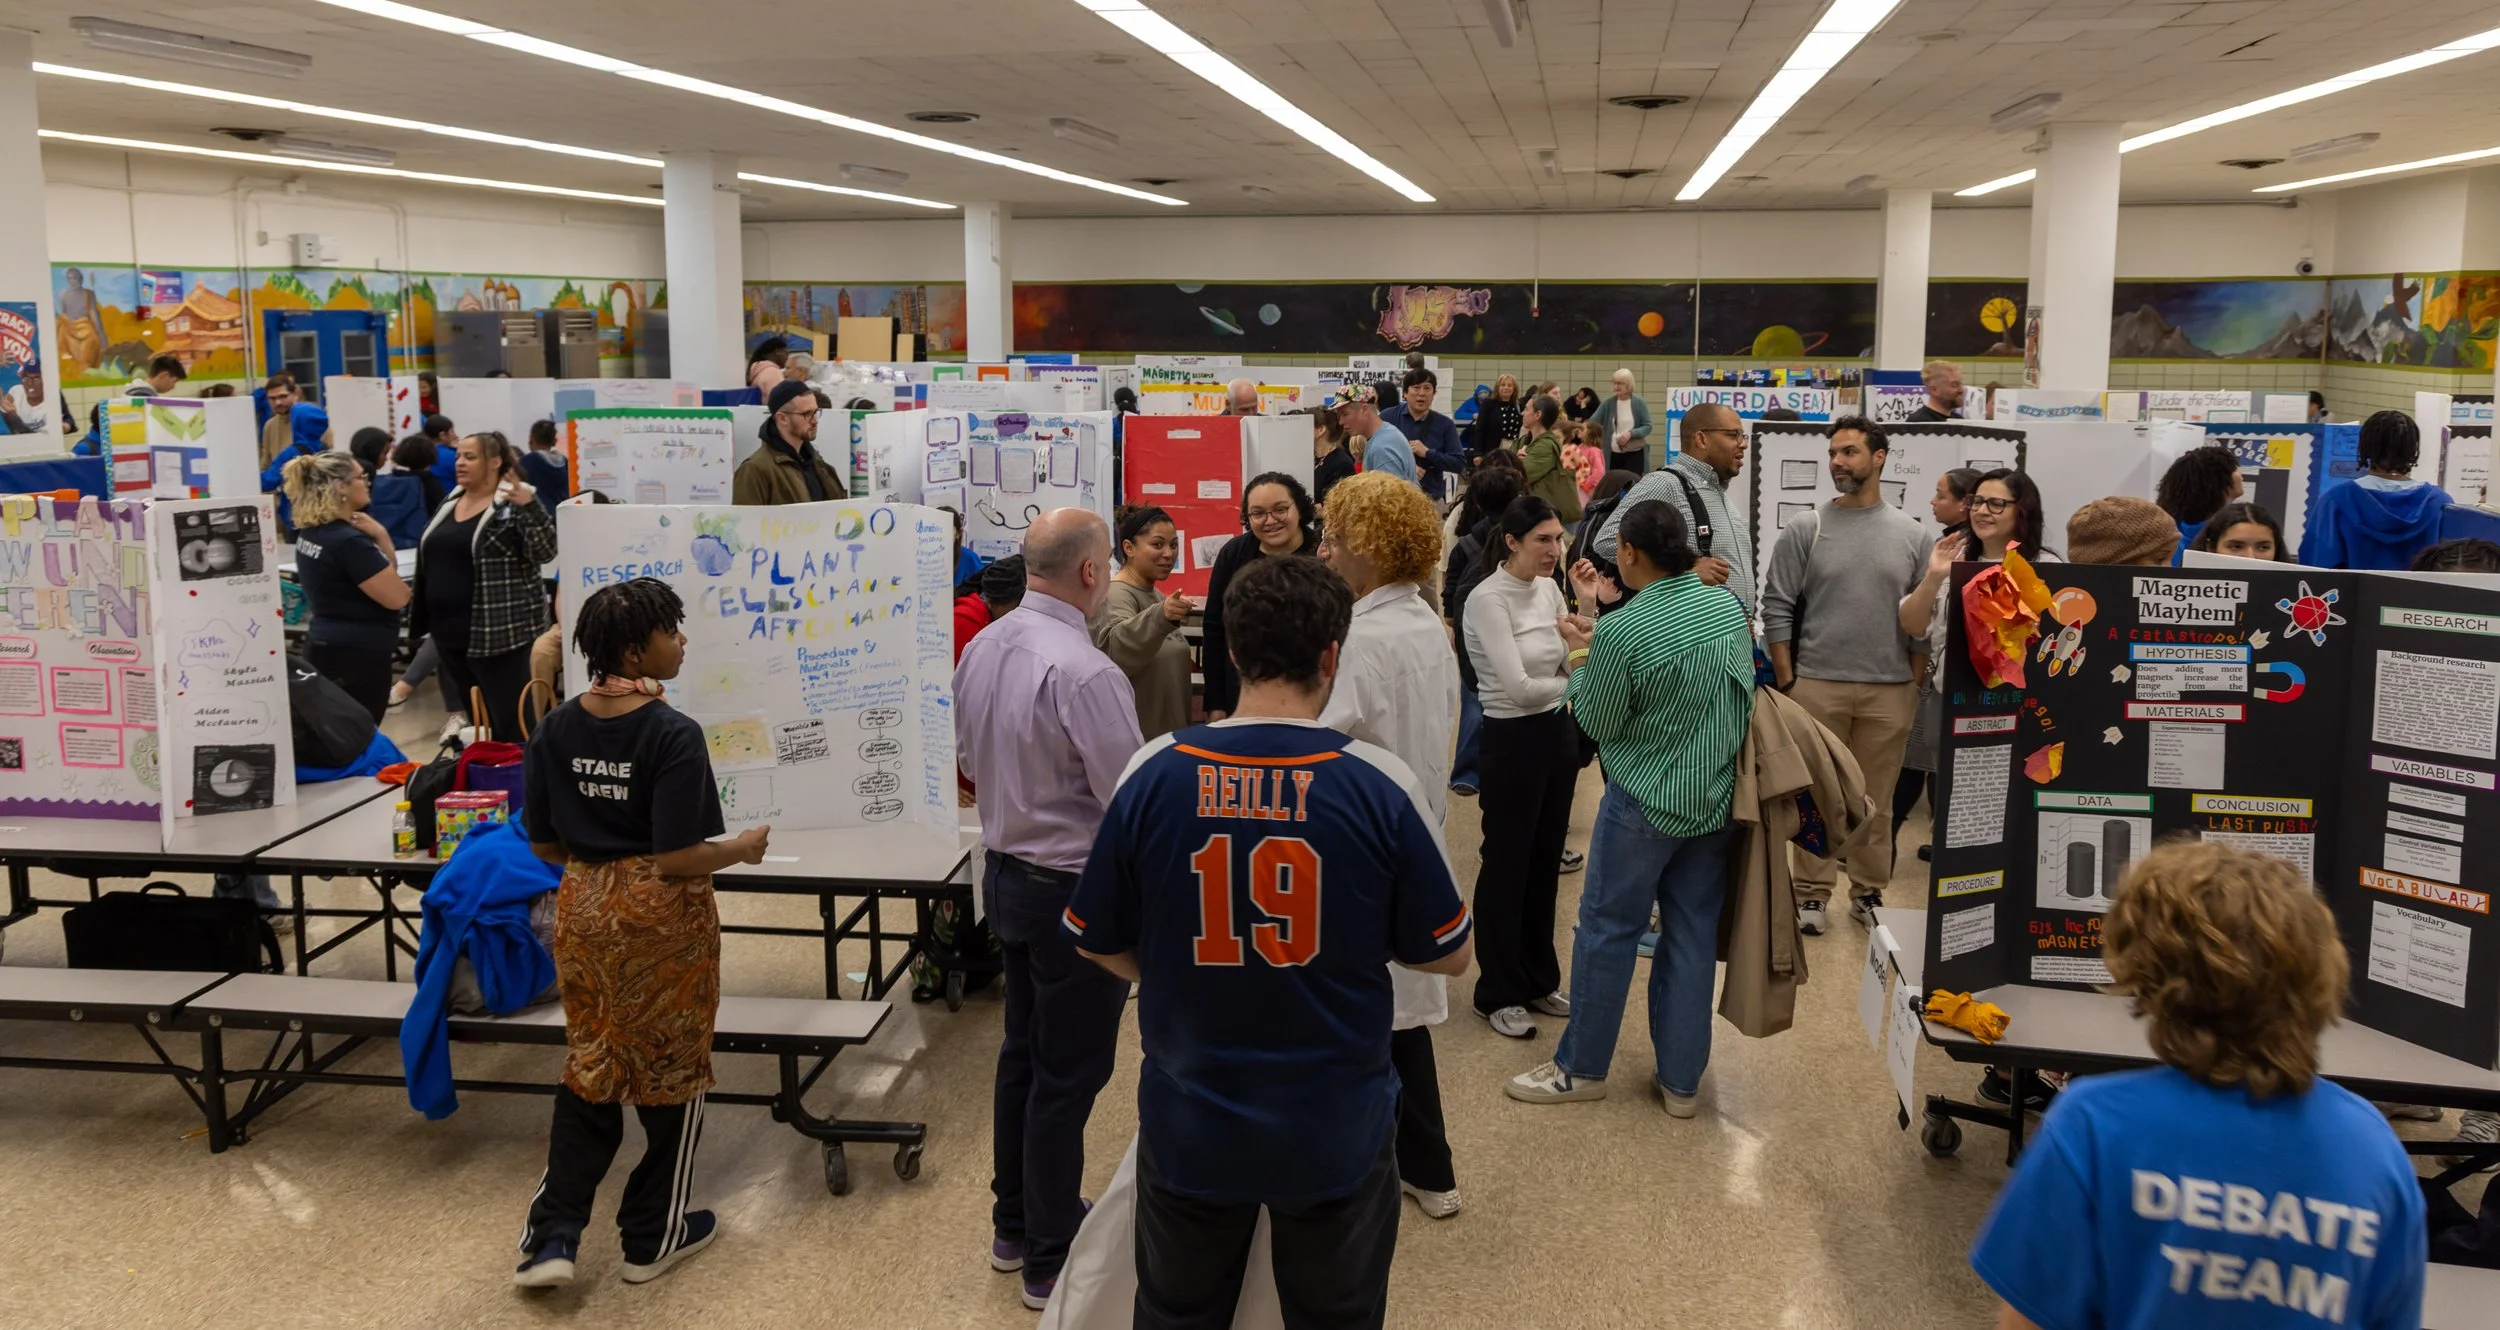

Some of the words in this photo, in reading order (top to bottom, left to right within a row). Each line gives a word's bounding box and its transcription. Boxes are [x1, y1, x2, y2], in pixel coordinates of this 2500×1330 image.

[1142, 367, 1192, 381] MAGNETIC
[1751, 392, 1782, 410] DA
[834, 506, 896, 542] DO
[582, 559, 684, 588] RESEARCH
[750, 543, 866, 586] PLANT
[2139, 580, 2242, 602] Magnetic
[2403, 613, 2489, 632] RESEARCH
[2108, 627, 2118, 640] A
[797, 647, 859, 662] Procedure
[2146, 647, 2237, 661] HYPOTHESIS
[2391, 651, 2444, 666] Background
[2446, 660, 2486, 669] research
[2137, 674, 2174, 682] magnets
[2175, 665, 2204, 674] adding
[2137, 683, 2161, 691] range
[194, 708, 230, 716] Aiden
[2145, 706, 2225, 719] MATERIALS
[1966, 718, 2008, 731] ABSTRACT
[572, 757, 632, 779] STAGE
[2392, 760, 2476, 784] VARIABLES
[579, 780, 629, 801] CREW
[1197, 765, 1314, 821] REILLY
[2077, 796, 2113, 807] DATA
[2206, 799, 2300, 814] CONCLUSION
[2208, 816, 2254, 833] LAST
[1946, 875, 1996, 893] PROCEDURE
[1190, 833, 1322, 968] 19
[2397, 908, 2446, 929] Vocabulary
[2131, 1167, 2381, 1259] DEBATE
[2160, 1243, 2350, 1326] TEAM
